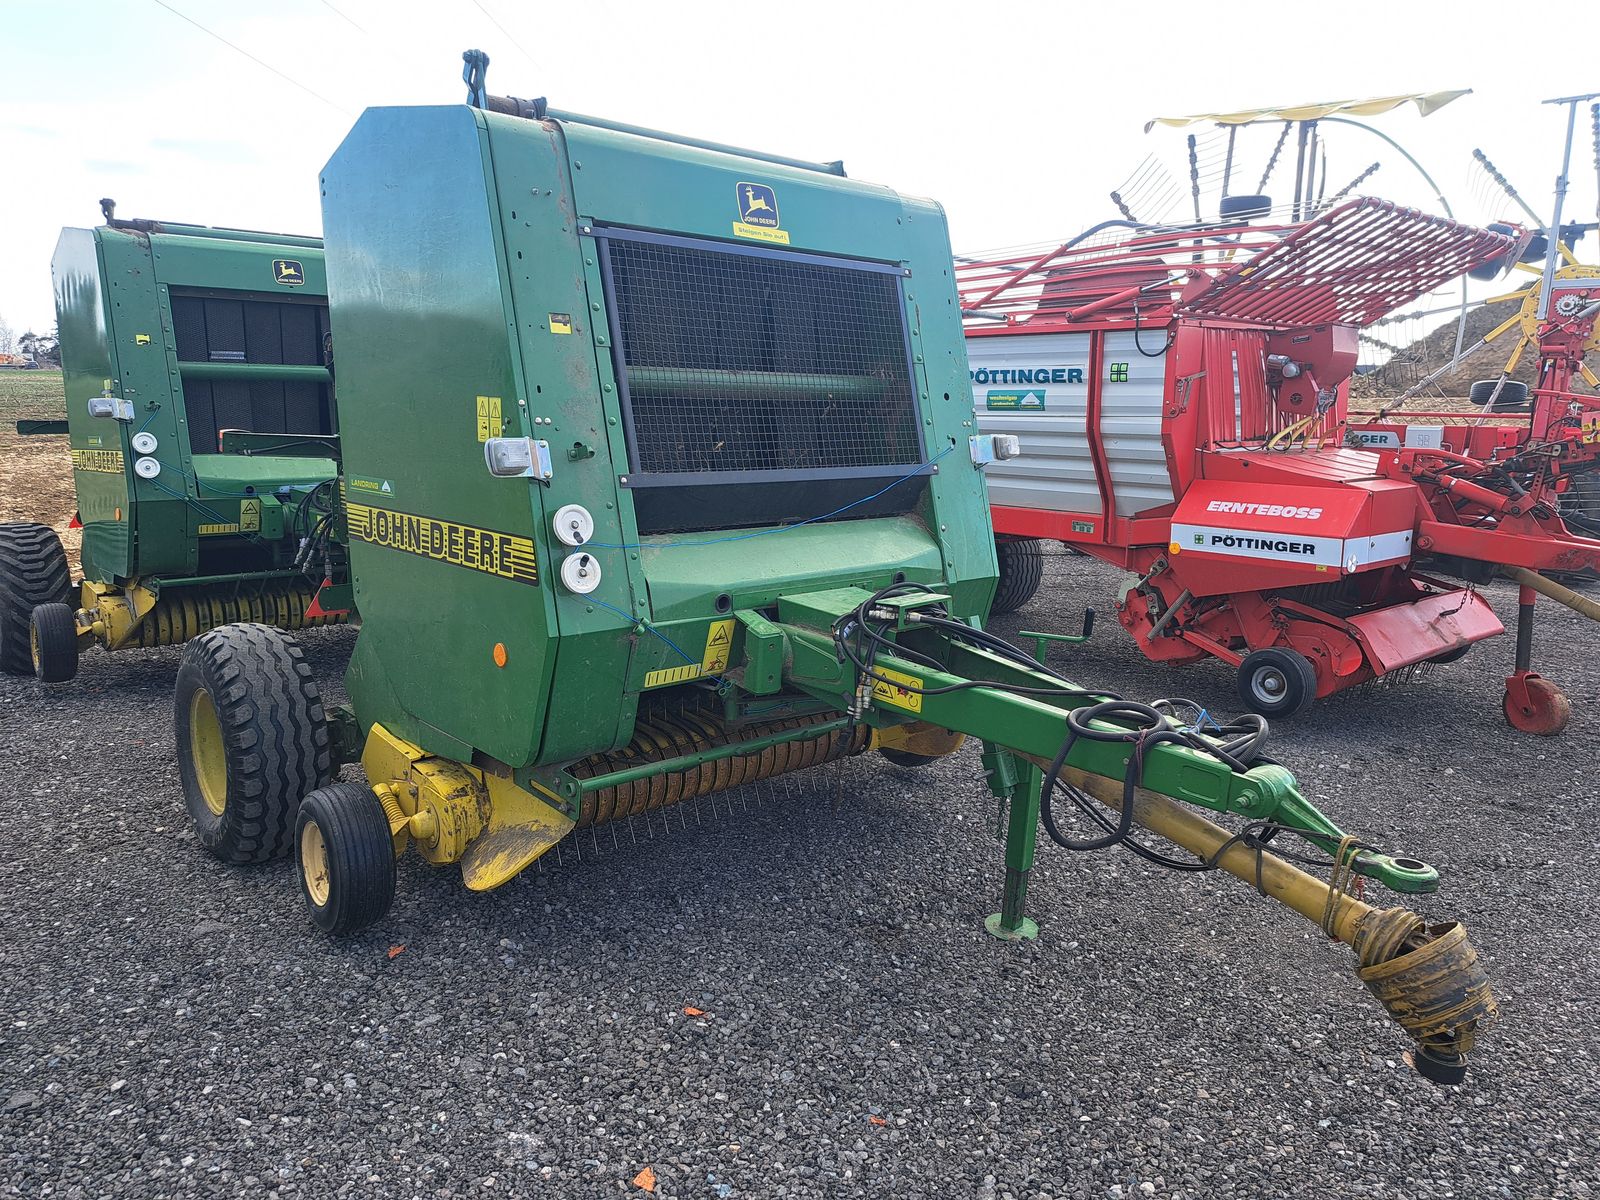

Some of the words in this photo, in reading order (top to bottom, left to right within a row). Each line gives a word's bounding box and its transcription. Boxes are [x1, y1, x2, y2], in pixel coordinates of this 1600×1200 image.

[744, 215, 759, 224] JOHN
[759, 217, 777, 226] DEERE
[78, 450, 96, 469] JOHN
[96, 451, 119, 471] DEERE
[1206, 500, 1324, 520] ERNTEBOSS
[362, 508, 421, 551] JOHN
[429, 521, 513, 573] DEERE
[1210, 534, 1316, 556] PÖTTINGER
